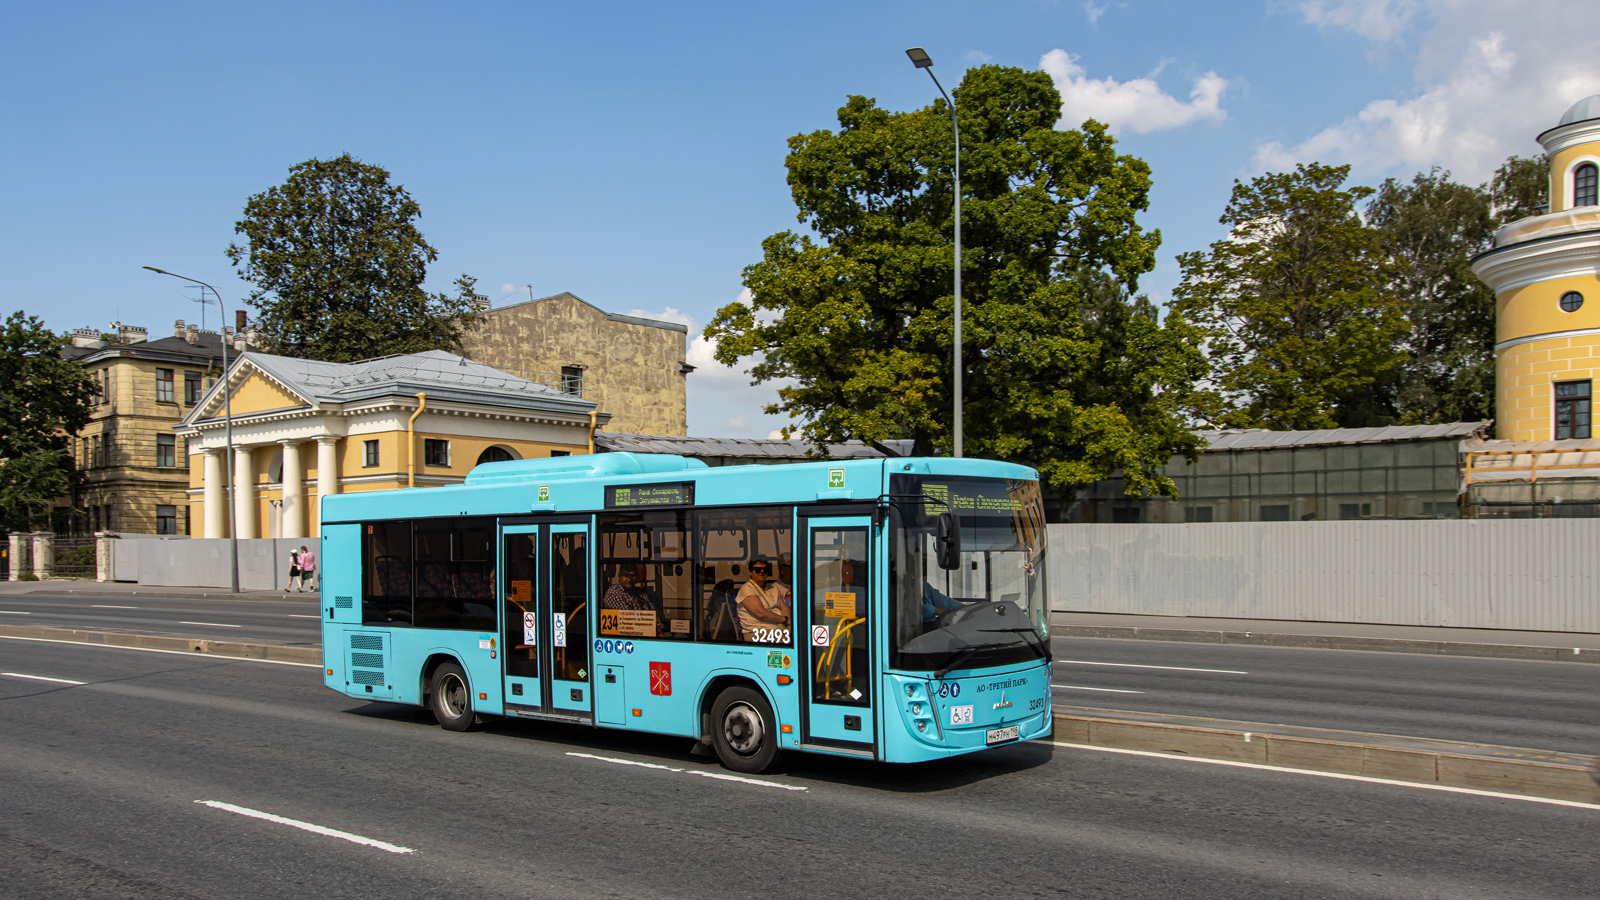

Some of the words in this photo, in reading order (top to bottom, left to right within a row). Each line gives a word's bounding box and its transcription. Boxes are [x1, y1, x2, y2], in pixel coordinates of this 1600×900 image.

[602, 614, 618, 630] 234
[752, 628, 790, 644] 32493
[976, 684, 986, 693] АО
[986, 678, 1012, 691] «ТРЕТИЙ
[1012, 677, 1028, 687] ПАРК»
[1029, 697, 1044, 710] 32493
